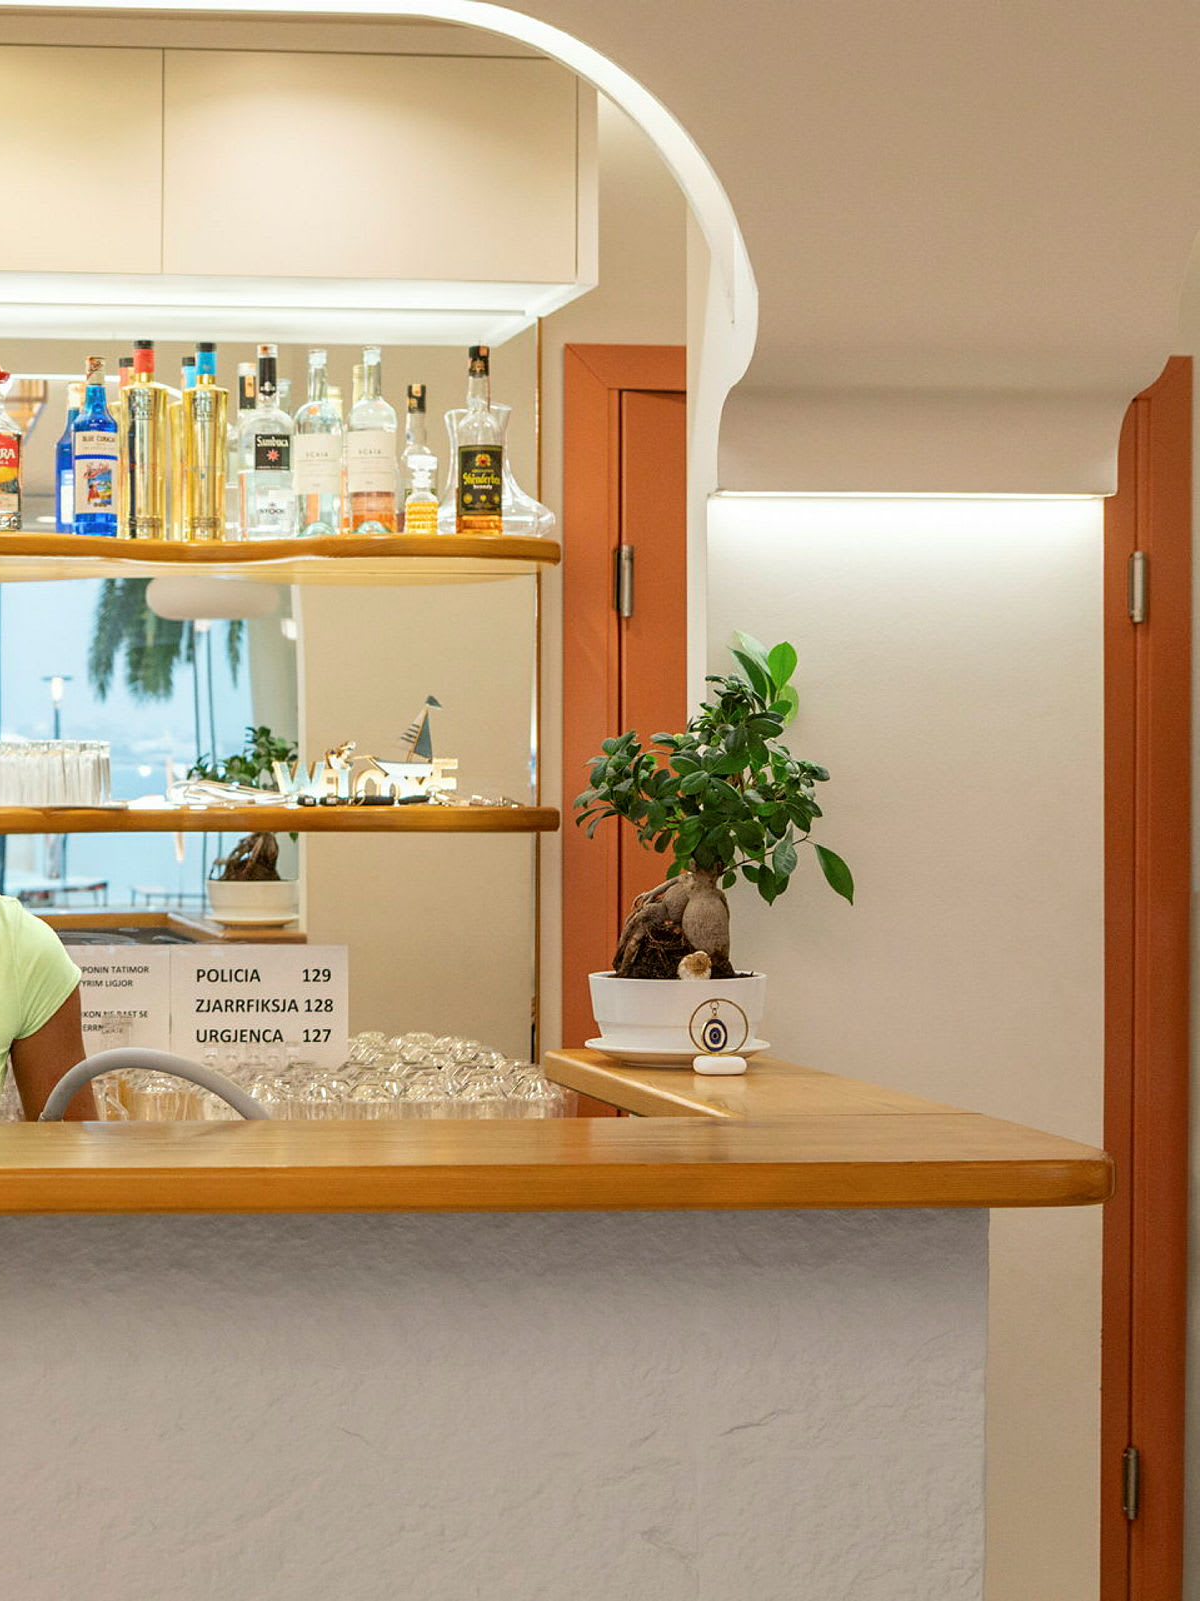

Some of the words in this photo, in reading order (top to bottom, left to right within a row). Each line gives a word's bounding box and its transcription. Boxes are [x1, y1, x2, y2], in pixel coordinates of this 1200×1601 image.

[81, 966, 109, 974] PONIN
[110, 966, 150, 974] TATIMOR
[196, 968, 261, 983] POLICIA
[302, 968, 332, 983] 129
[105, 979, 133, 988] LIGJOR
[195, 998, 299, 1013] ZJARRFIKSJA
[304, 998, 334, 1013] 128
[196, 1028, 284, 1043] URGJENCA
[302, 1028, 332, 1043] 127
